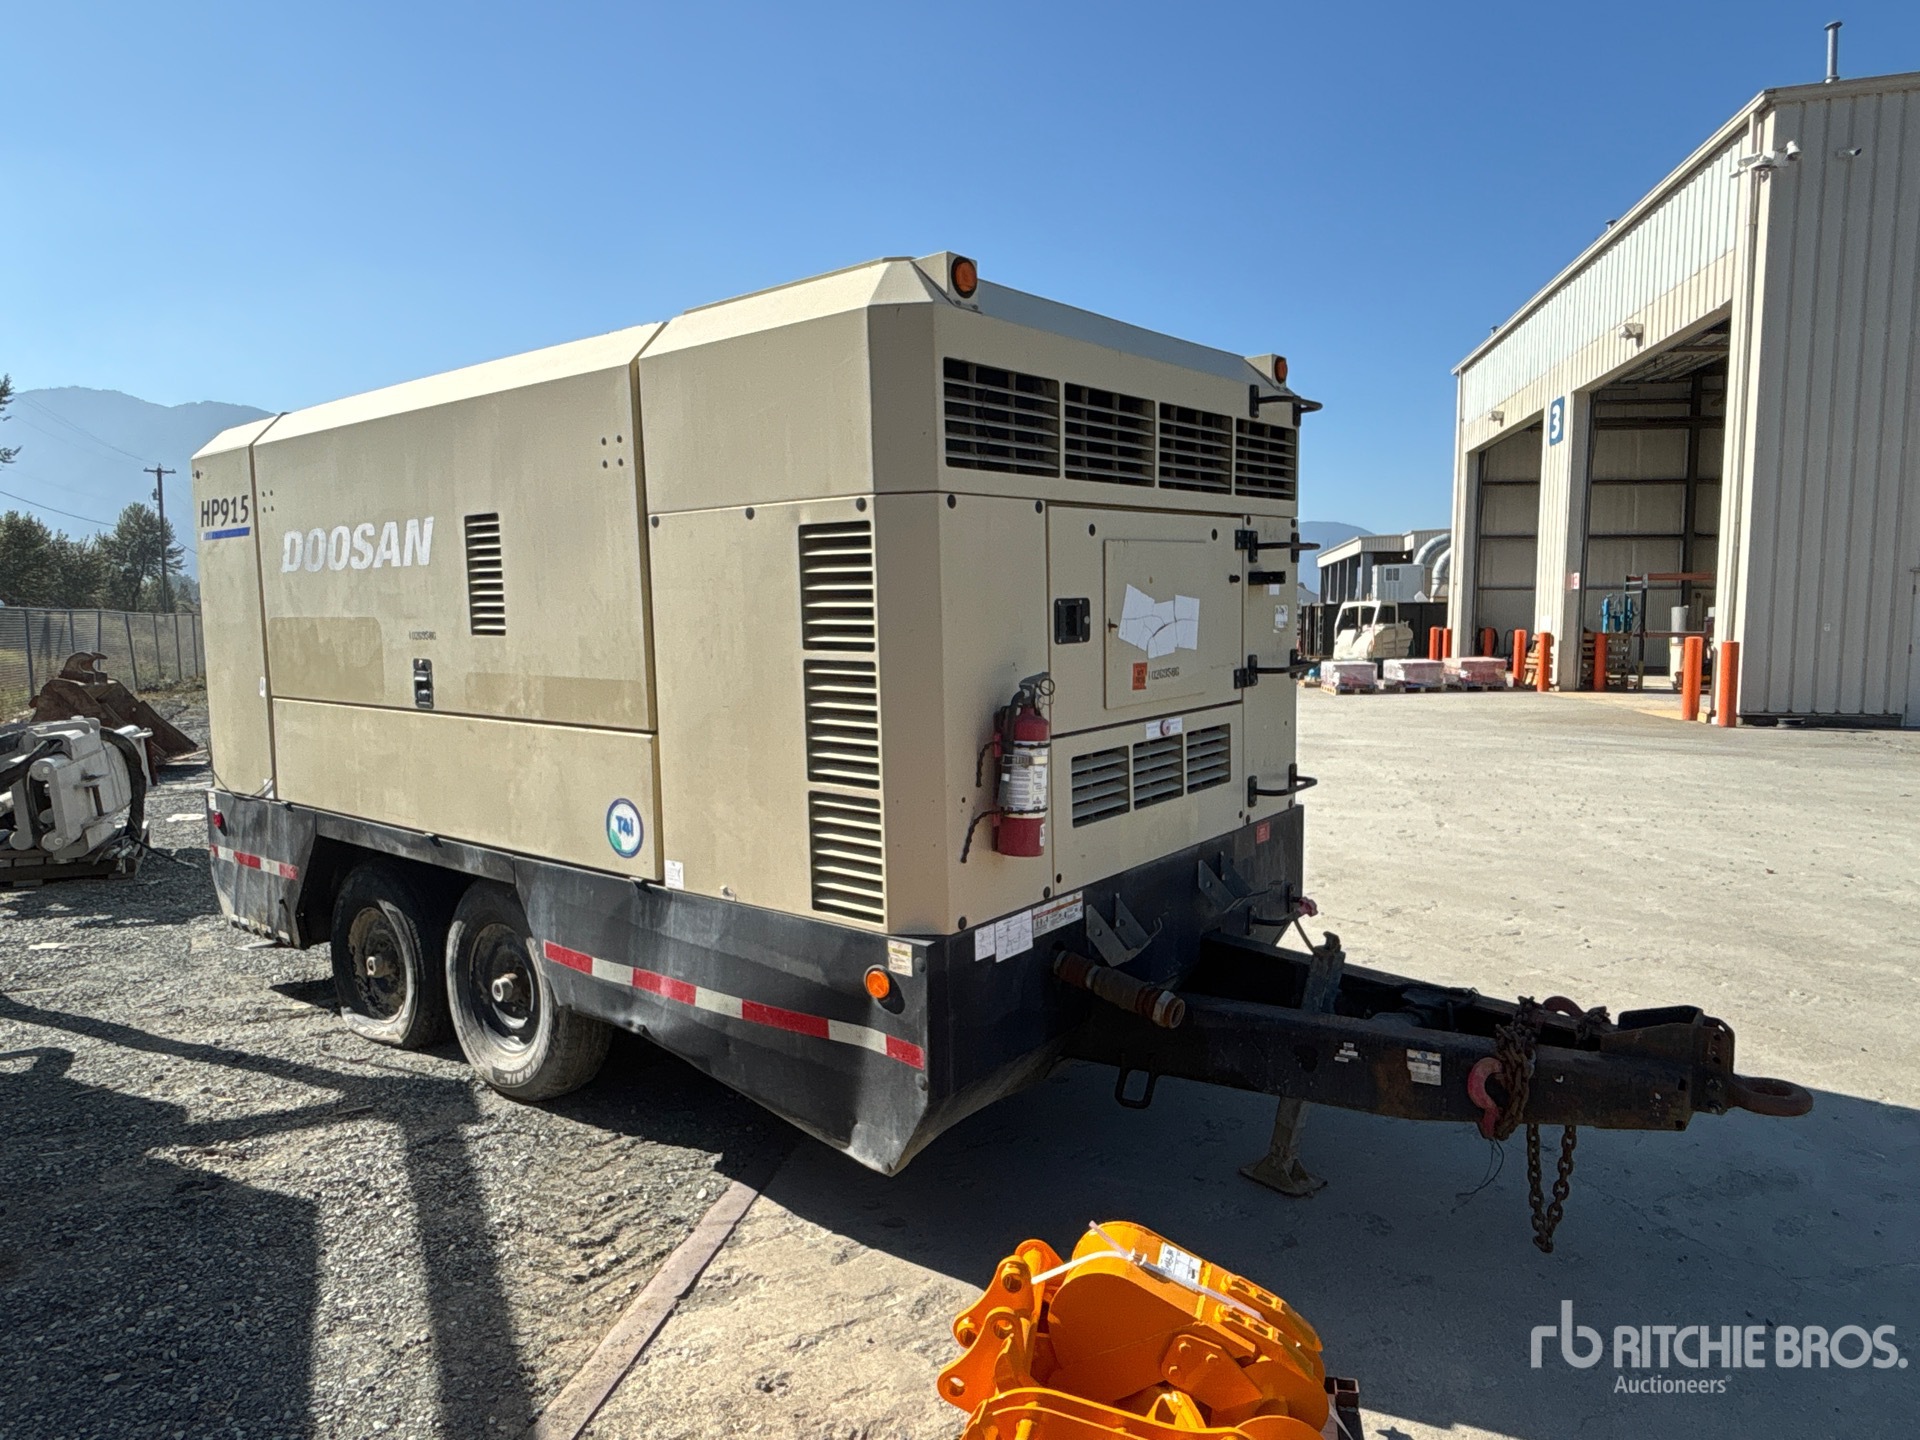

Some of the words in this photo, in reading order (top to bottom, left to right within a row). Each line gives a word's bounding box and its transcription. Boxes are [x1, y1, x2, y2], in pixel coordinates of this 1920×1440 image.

[1551, 404, 1561, 440] 3
[200, 494, 249, 528] HP915
[280, 516, 435, 574] DOOSAN
